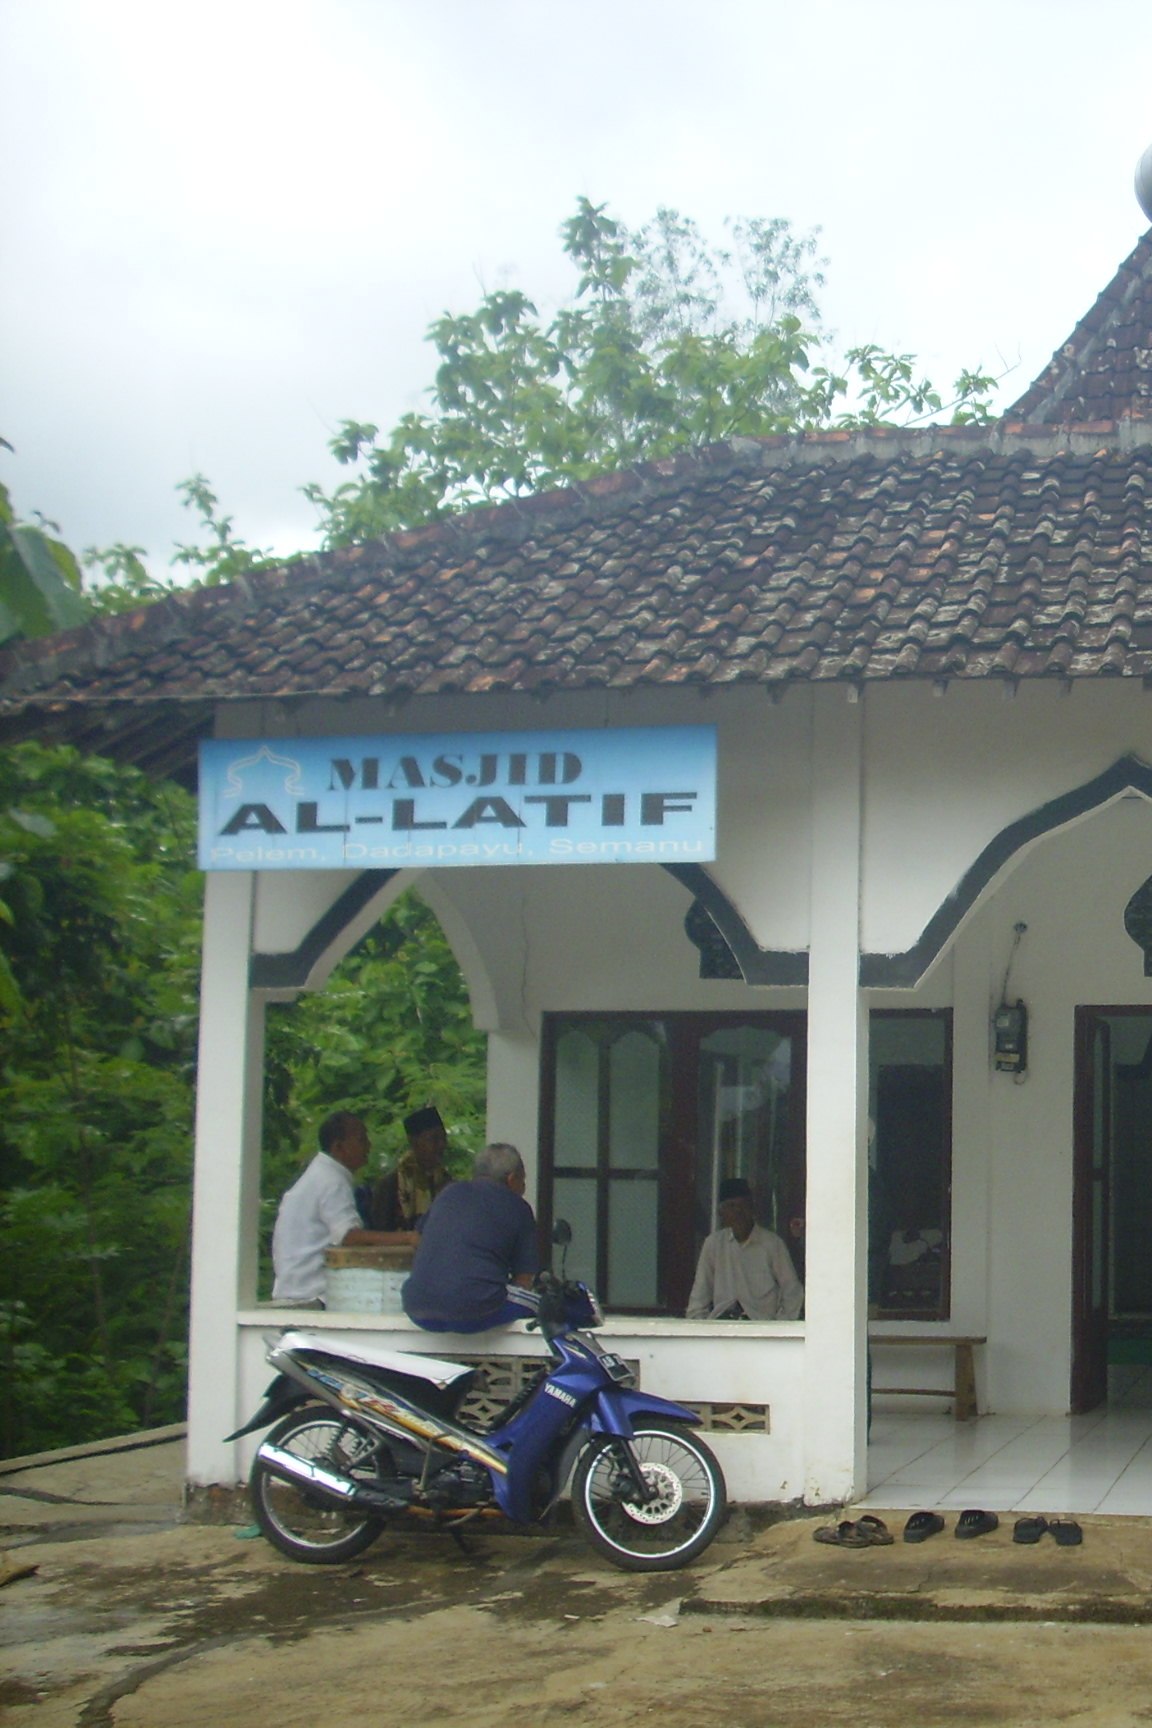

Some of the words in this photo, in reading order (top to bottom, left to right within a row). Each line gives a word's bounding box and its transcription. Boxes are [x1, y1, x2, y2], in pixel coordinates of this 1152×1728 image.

[327, 751, 583, 791] MASJID
[219, 791, 698, 836] AL-LATIF
[210, 846, 326, 863] Pelem,
[342, 841, 534, 861] Dadapayu,
[548, 837, 704, 855] Semanu
[544, 1382, 577, 1409] YAMAHA
